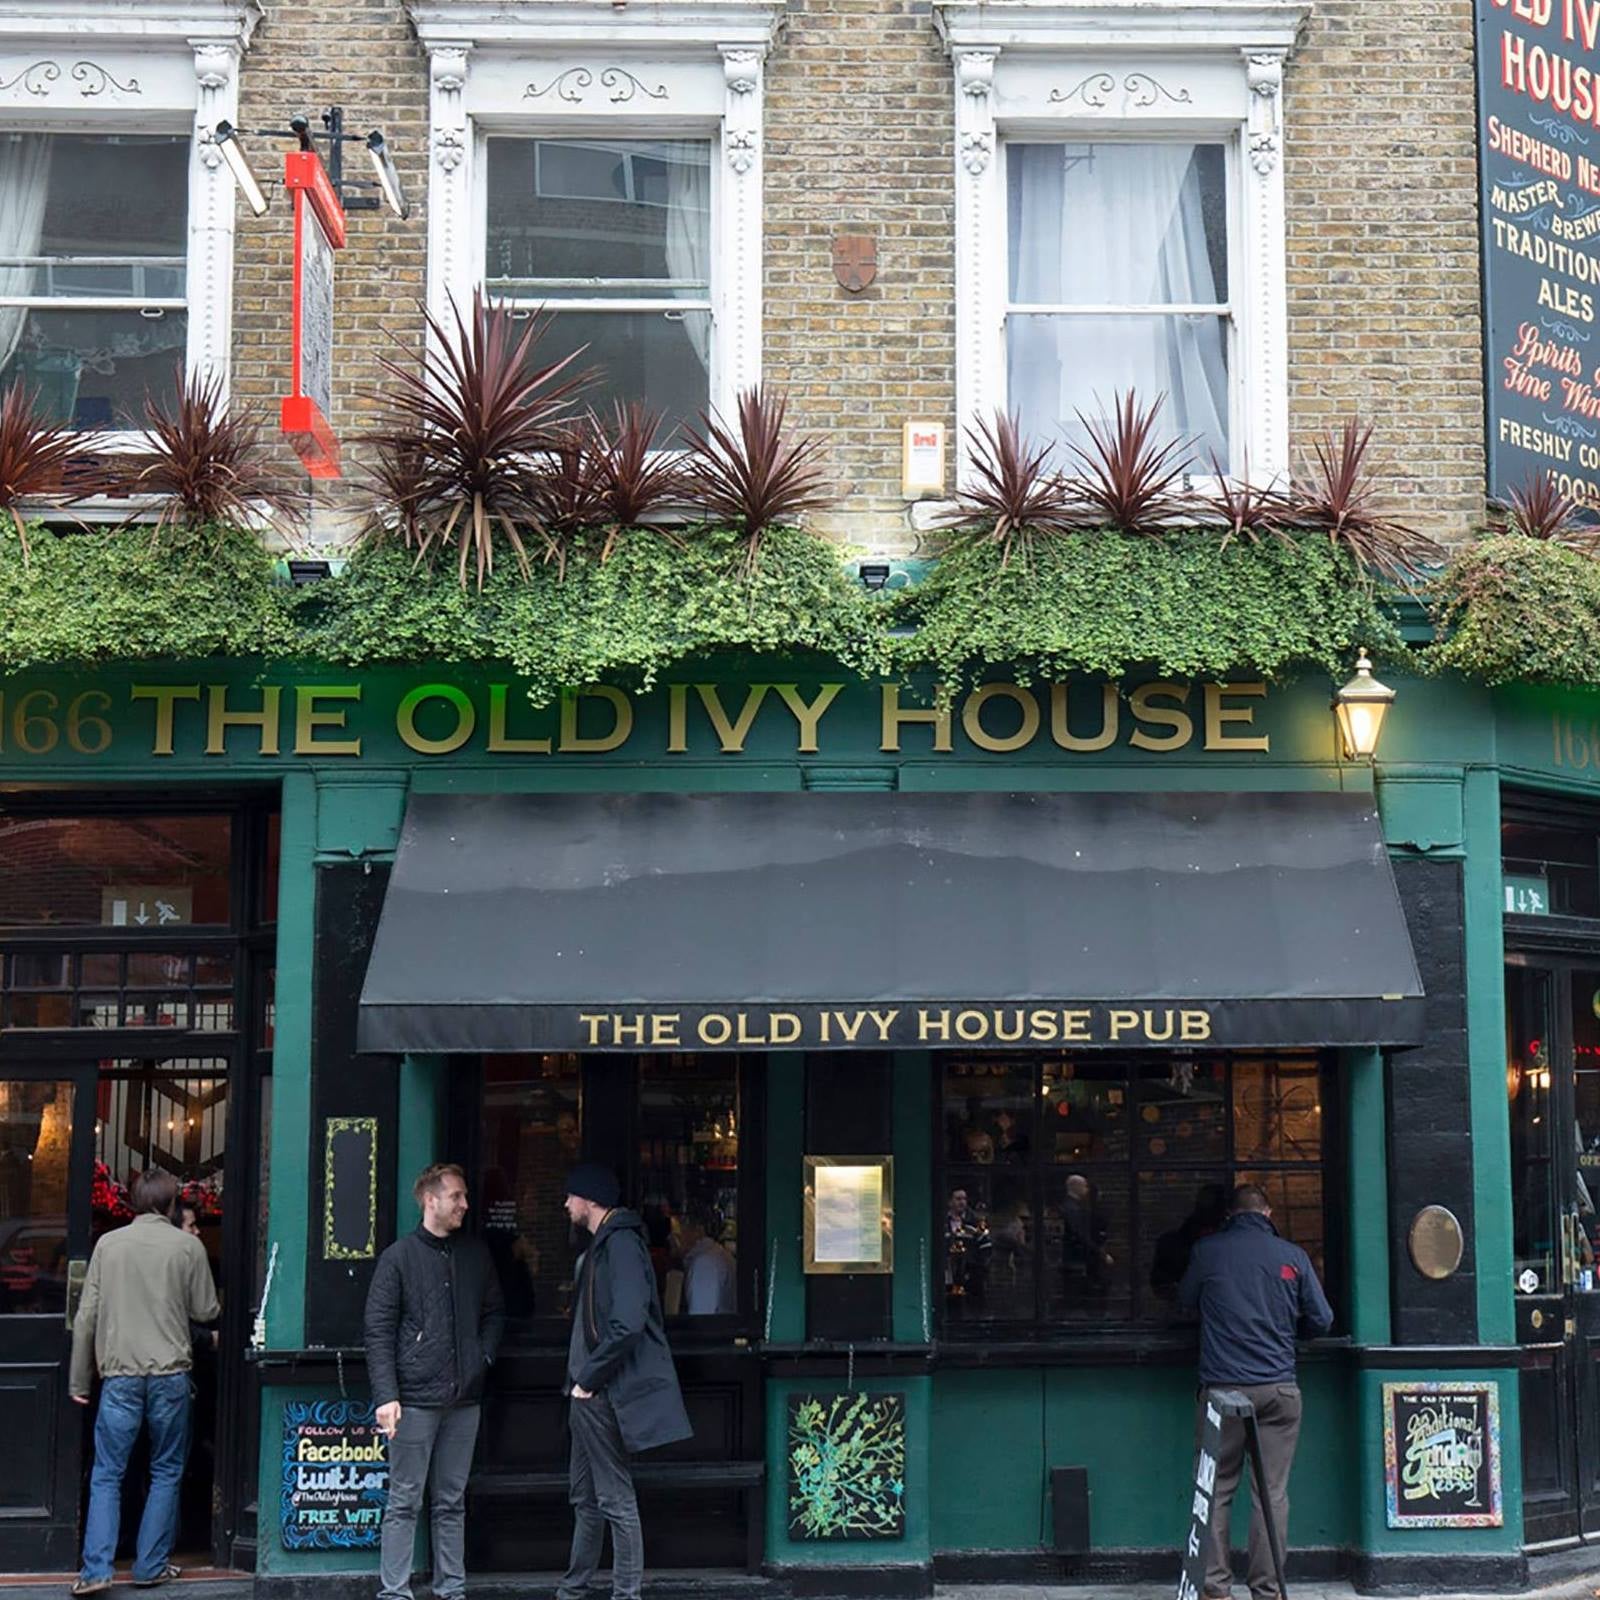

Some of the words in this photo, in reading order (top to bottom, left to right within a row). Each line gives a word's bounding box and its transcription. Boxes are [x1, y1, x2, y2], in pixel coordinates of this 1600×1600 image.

[1487, 115, 1572, 182] SHEPHERD
[1491, 180, 1564, 213] MASTER
[1537, 278, 1594, 323] ALES
[1514, 321, 1582, 377] Spirits
[1503, 357, 1552, 402] Fine
[1500, 417, 1573, 462] FRESHLY
[131, 684, 361, 756] THE
[396, 684, 633, 755] OLD
[667, 683, 845, 753] IVY
[880, 682, 1270, 753] HOUSE
[580, 1013, 681, 1045] THE
[698, 1013, 802, 1044] OLD
[819, 1010, 899, 1042] IVY
[918, 1009, 1092, 1041] HOUSE
[1109, 1009, 1211, 1041] PUB
[298, 1426, 345, 1436] FOLLOW
[299, 1508, 340, 1524] FREE
